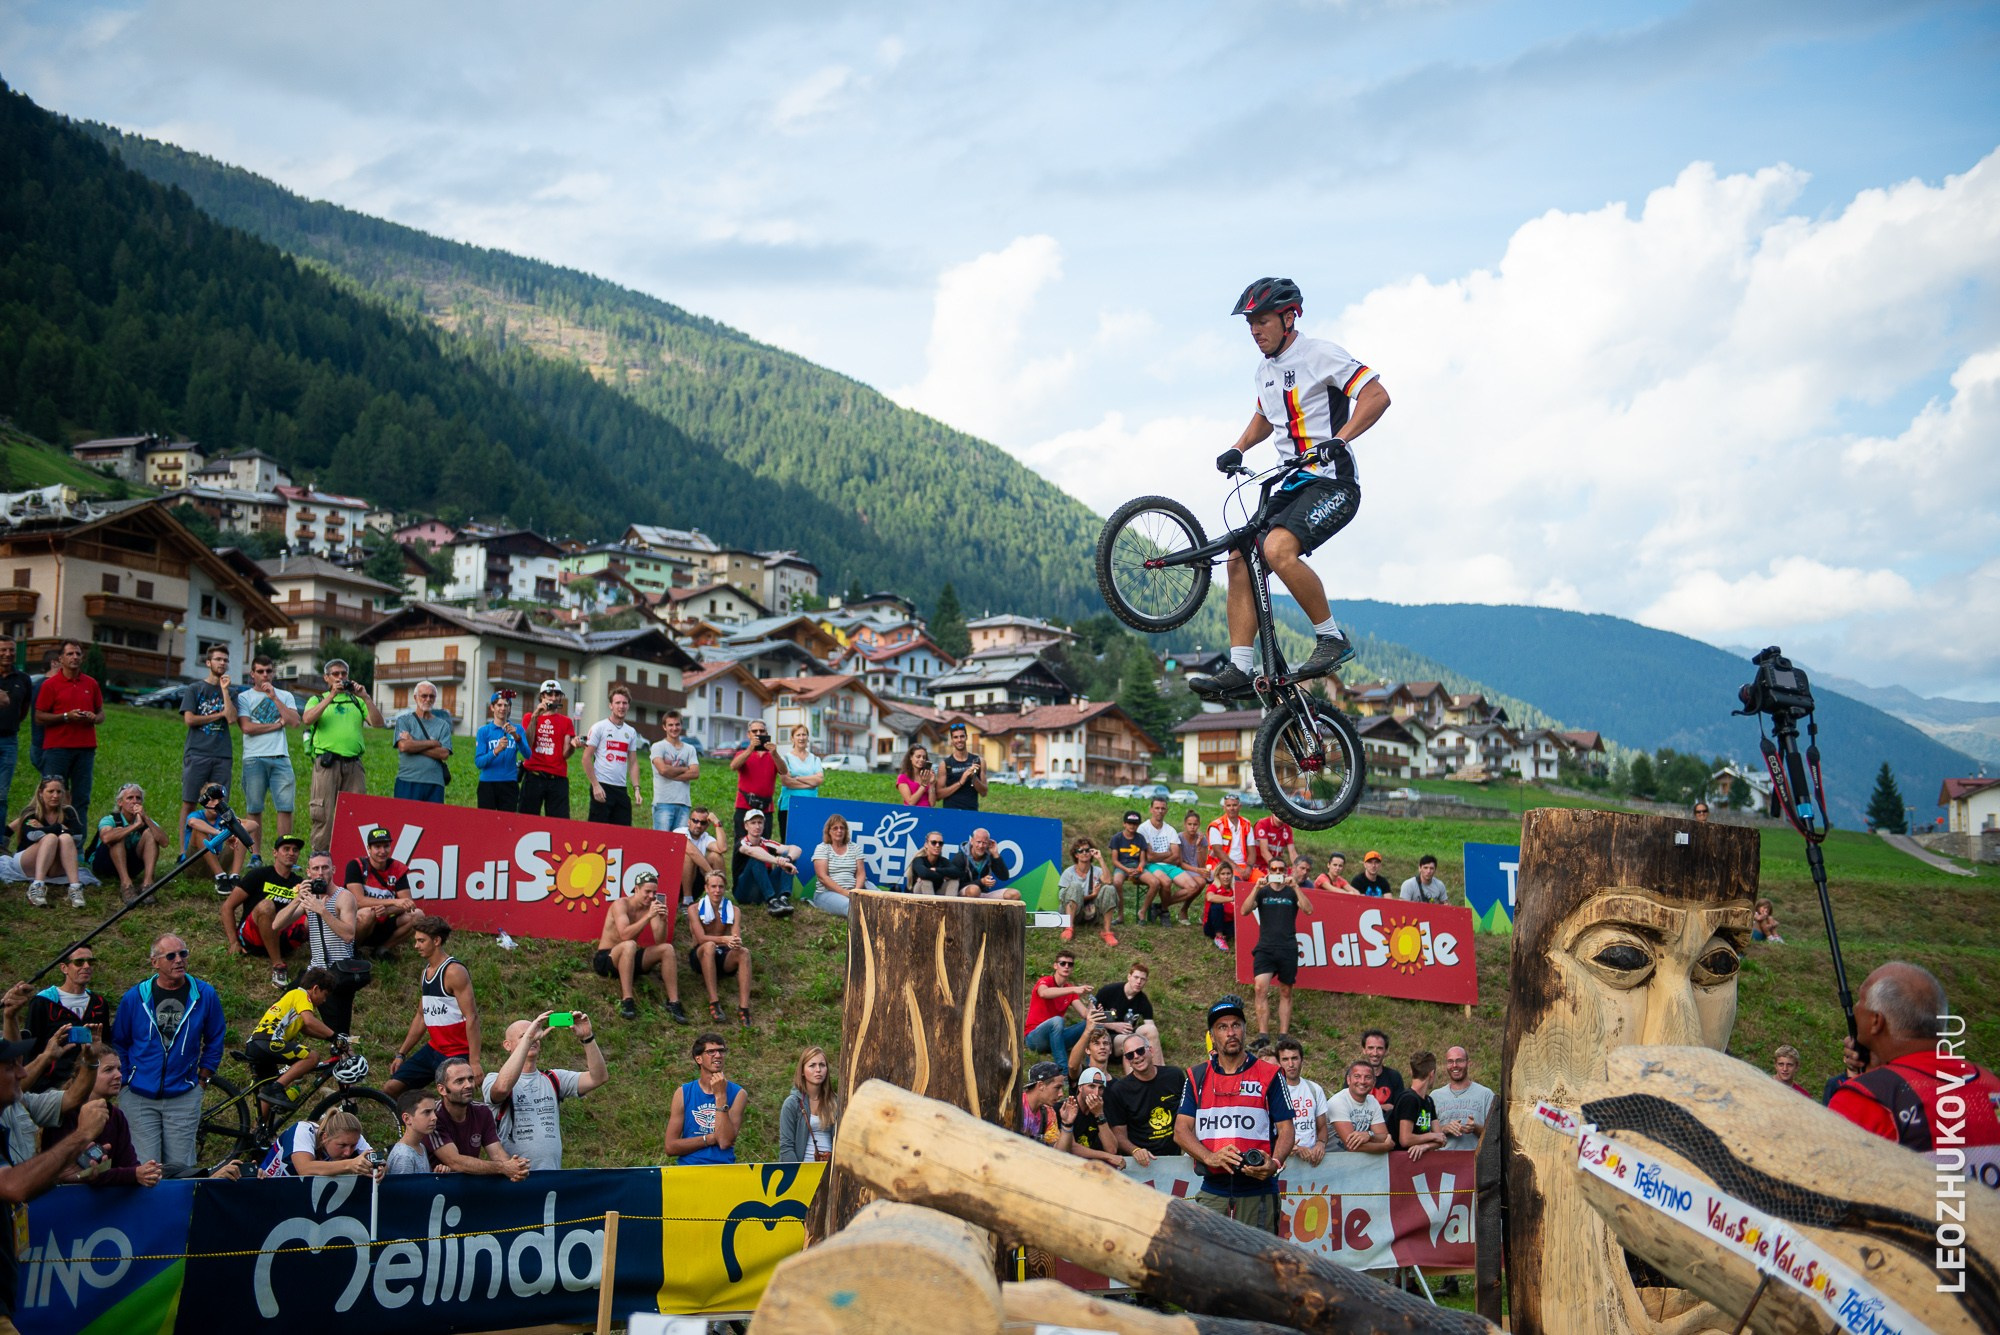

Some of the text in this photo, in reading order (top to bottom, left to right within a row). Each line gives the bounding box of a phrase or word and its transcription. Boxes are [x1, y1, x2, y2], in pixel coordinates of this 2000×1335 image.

[1768, 755, 1781, 774] EOS
[465, 859, 510, 900] di
[1331, 932, 1361, 967] di
[1199, 1114, 1256, 1132] PHOTO
[1633, 1162, 1692, 1213] TRENTINO
[1706, 1197, 1728, 1233] Val
[1725, 1221, 1737, 1239] di
[1772, 1234, 1796, 1277] Val
[1791, 1263, 1805, 1284] di
